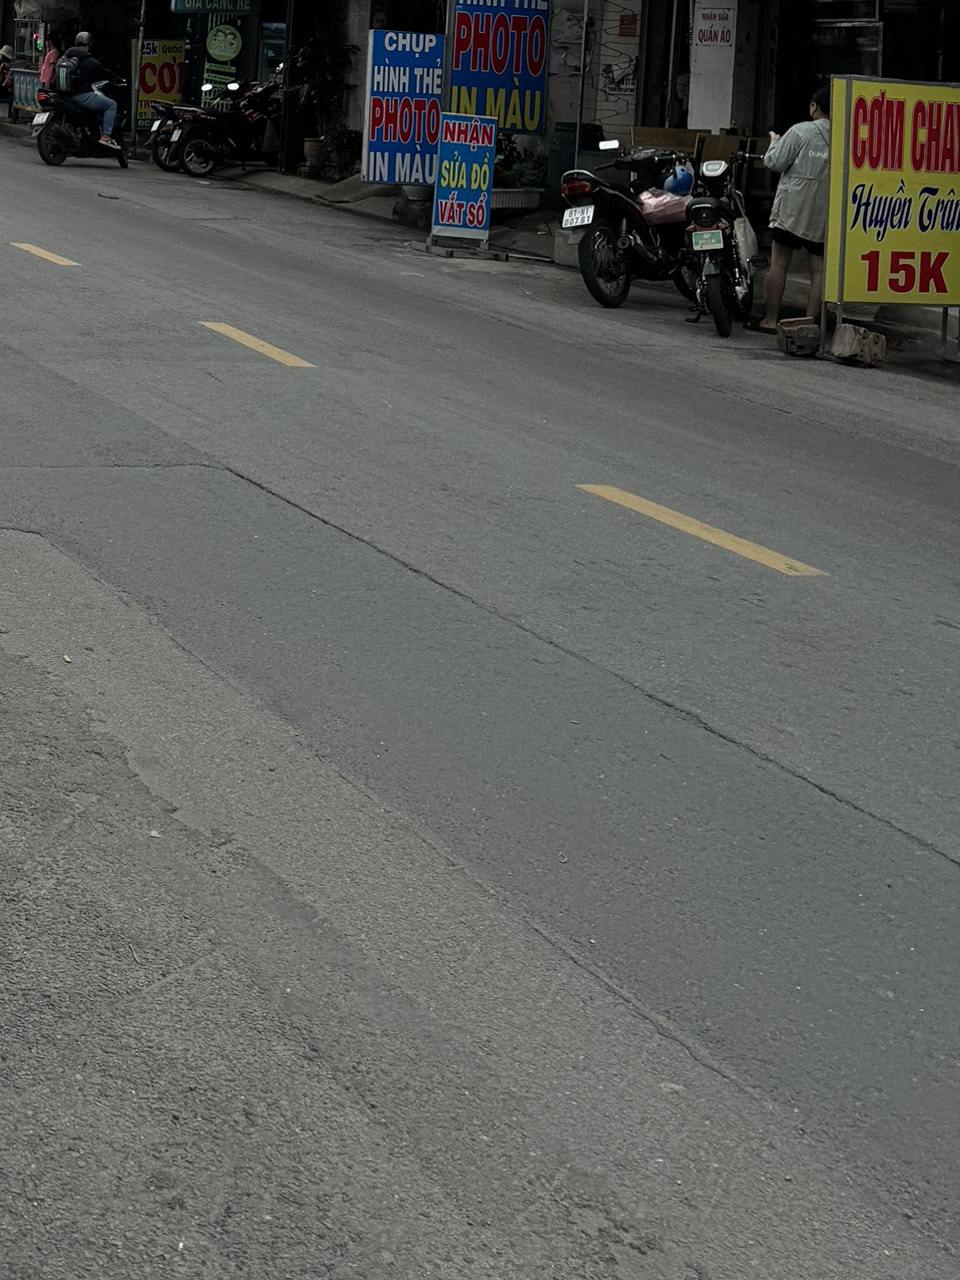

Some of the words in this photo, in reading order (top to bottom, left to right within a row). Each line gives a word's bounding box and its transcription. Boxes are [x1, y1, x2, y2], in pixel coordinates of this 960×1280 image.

[384, 32, 437, 58] CHỤP
[452, 10, 548, 77] PHOTO
[720, 26, 731, 43] ÁO
[373, 57, 410, 93] HÌNH
[413, 57, 443, 95] THẺ
[369, 96, 441, 145] PHOTO
[451, 85, 478, 115] IN
[485, 77, 541, 132] MÀU
[442, 118, 495, 151] NHẬN
[851, 90, 906, 172] CƠM
[369, 151, 389, 182] IN
[395, 143, 438, 184] MÀU
[440, 150, 467, 189] SỬA
[470, 152, 490, 192] ĐỒ
[438, 190, 465, 226] VẮT
[466, 193, 488, 227] SỔ
[850, 179, 912, 242] Huyền
[860, 250, 950, 294] 15K
